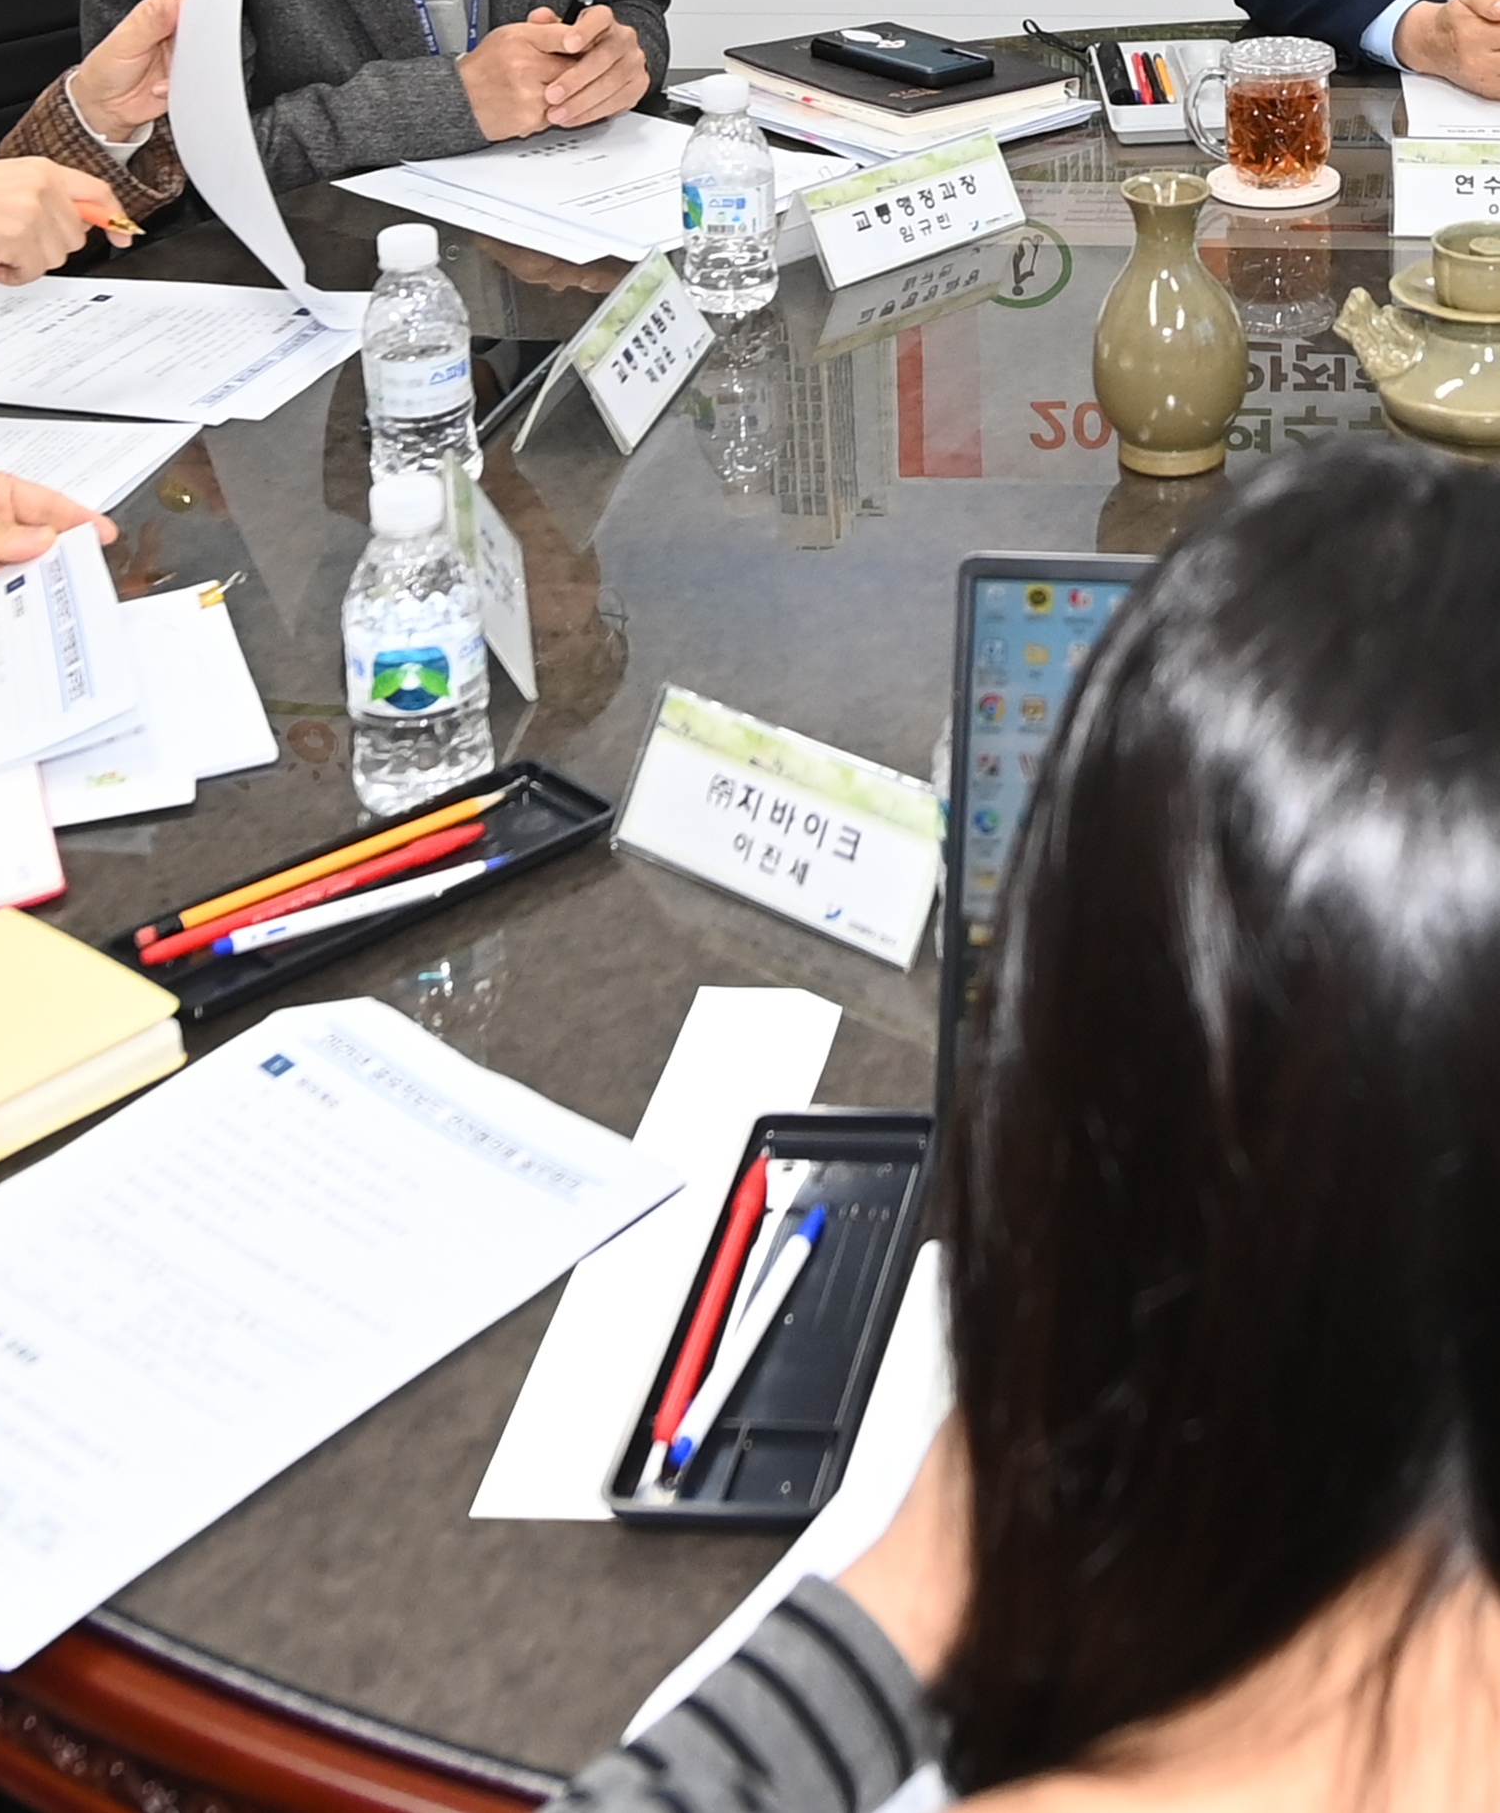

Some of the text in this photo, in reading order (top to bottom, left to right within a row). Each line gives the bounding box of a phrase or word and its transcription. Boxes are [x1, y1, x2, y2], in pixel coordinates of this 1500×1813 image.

[851, 174, 978, 233] 교통행정과장
[898, 212, 953, 244] 임규빈
[732, 831, 810, 887] 이진세
